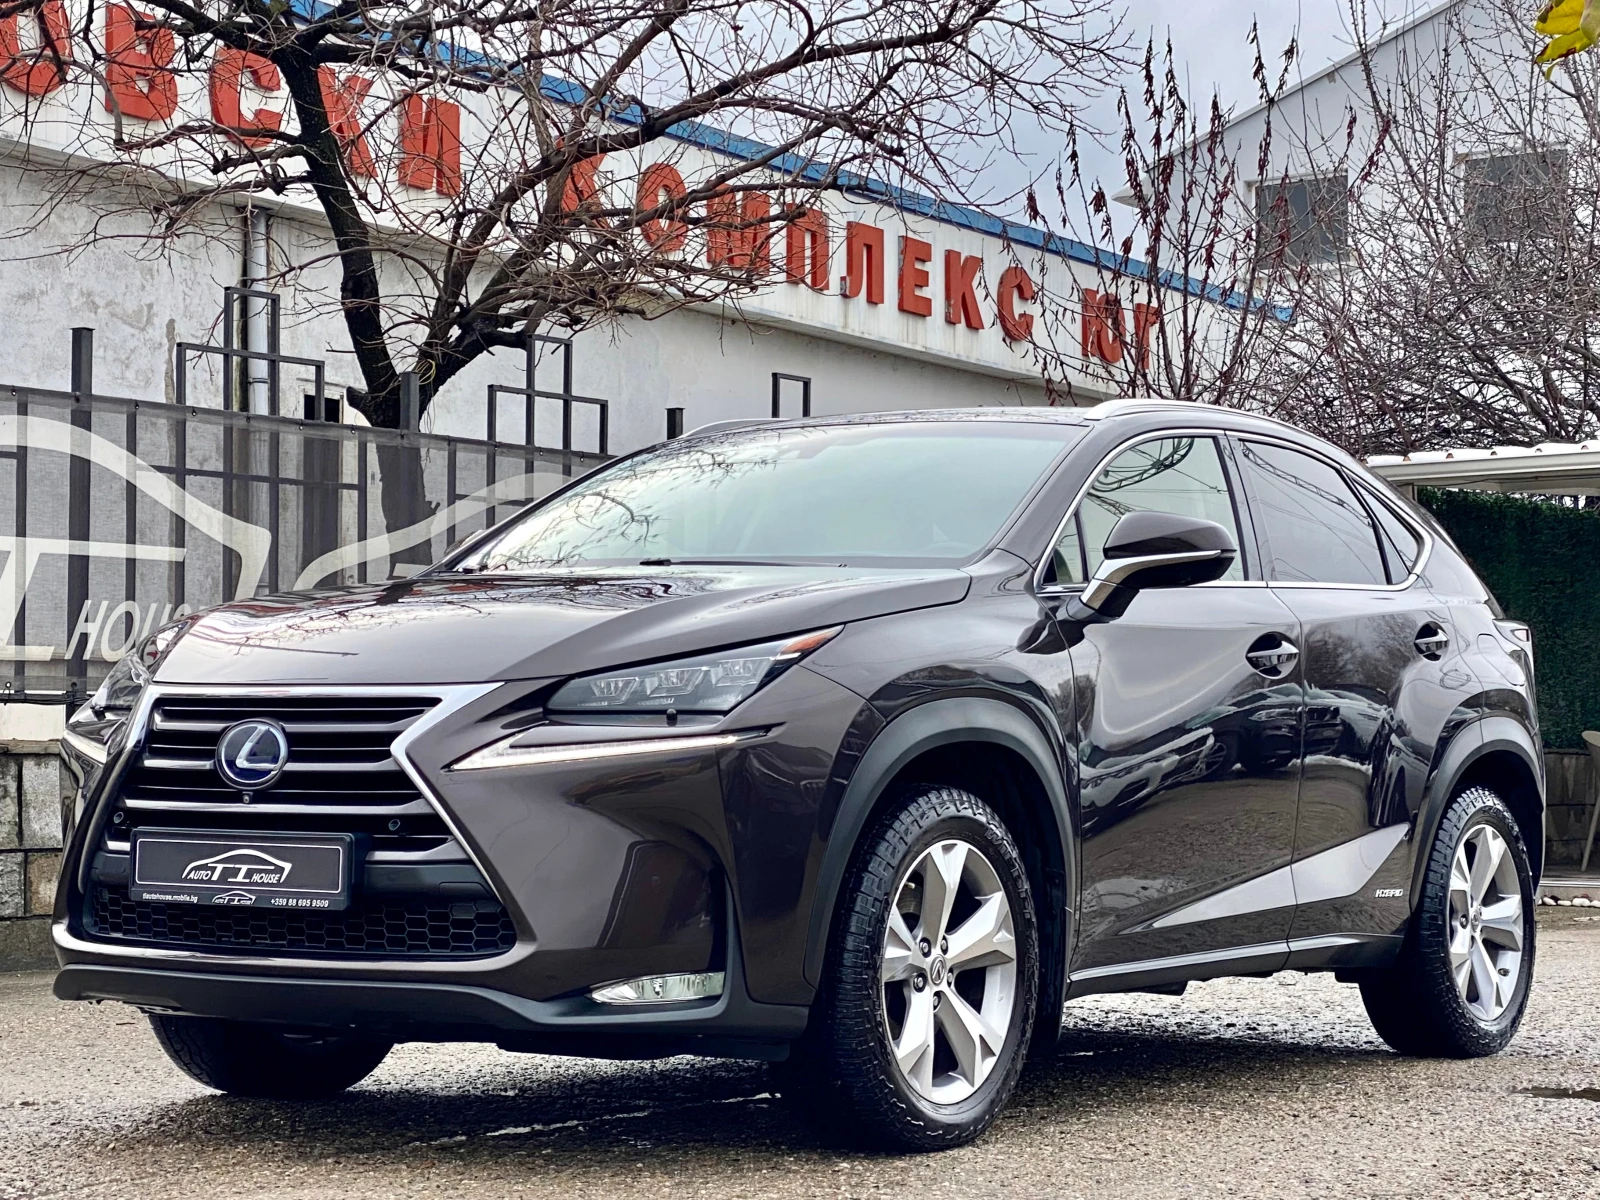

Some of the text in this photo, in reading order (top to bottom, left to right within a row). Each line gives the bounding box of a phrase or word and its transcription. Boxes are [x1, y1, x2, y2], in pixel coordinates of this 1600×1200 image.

[1081, 287, 1159, 370] ЮГ
[187, 870, 212, 880] AUTO
[250, 873, 281, 884] HOUSE
[270, 898, 329, 908] +359 88 695 9509
